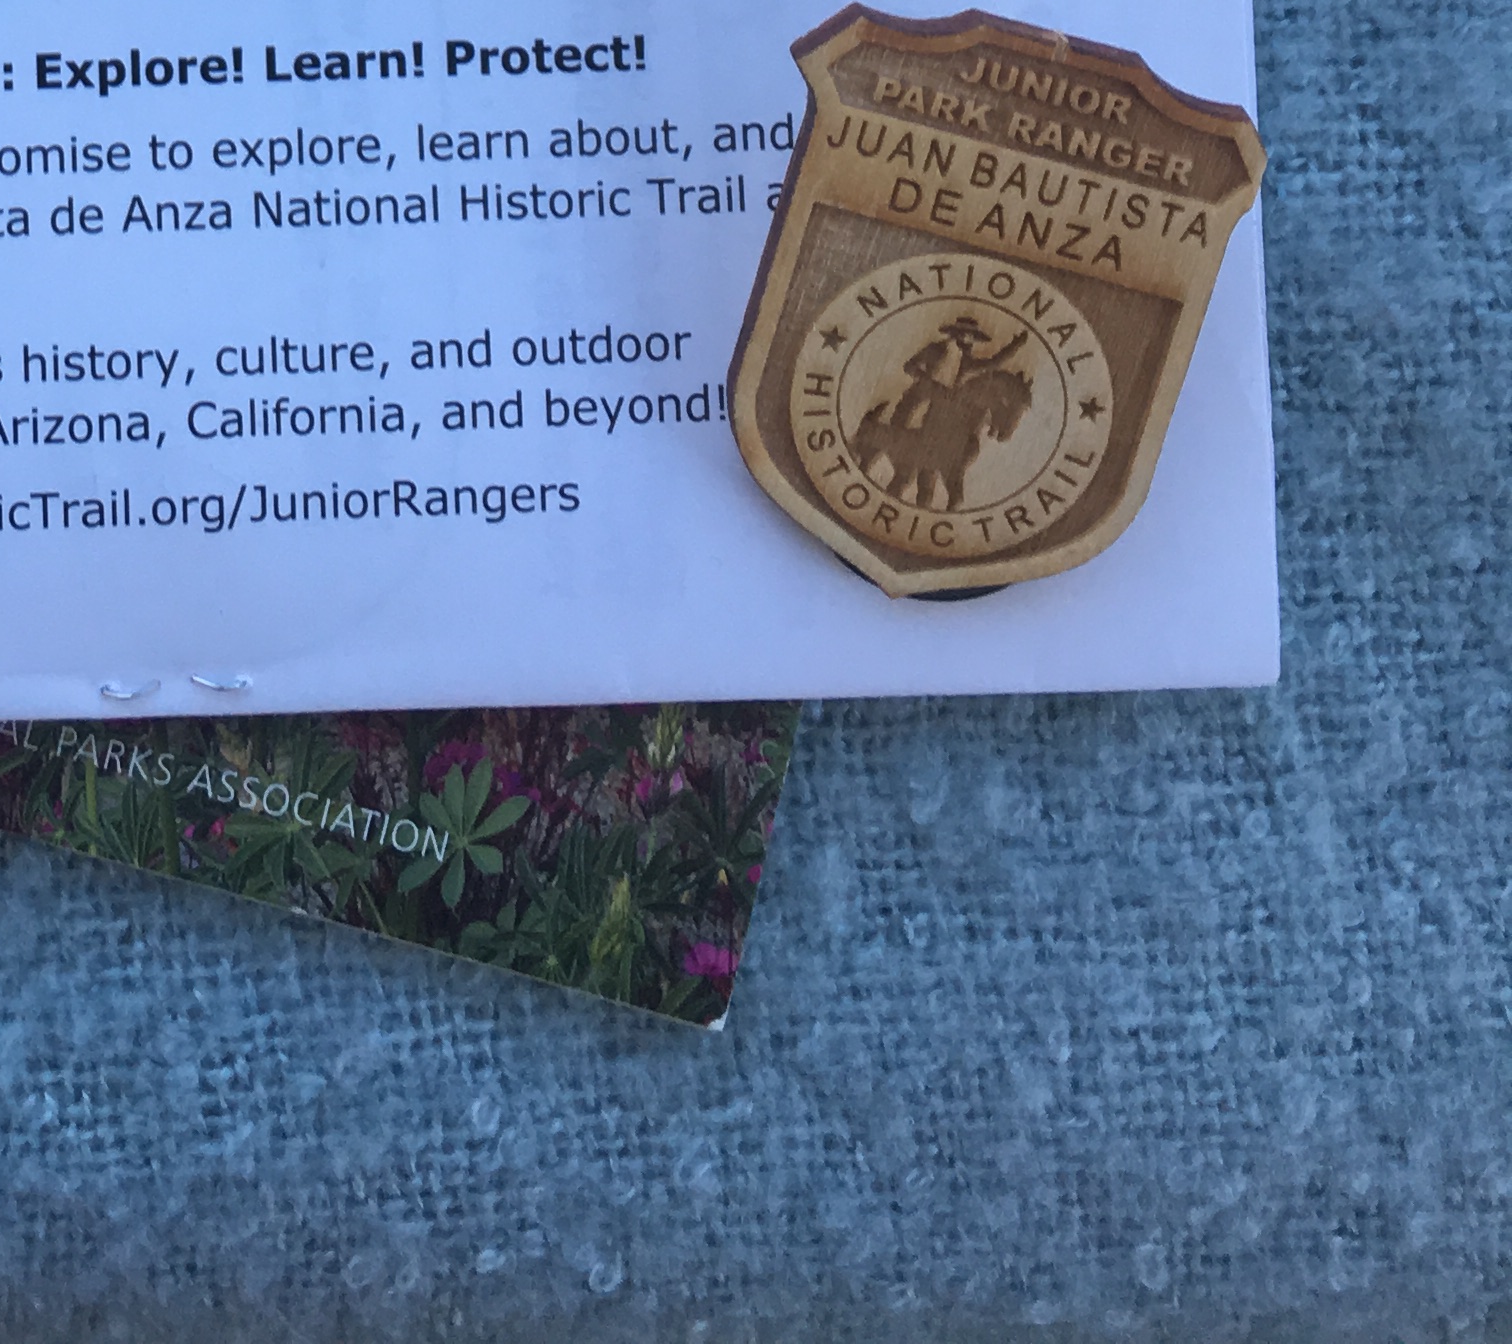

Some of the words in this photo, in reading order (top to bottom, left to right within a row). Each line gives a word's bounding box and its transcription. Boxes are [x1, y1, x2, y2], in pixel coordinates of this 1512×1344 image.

[34, 45, 245, 99] Explore!
[264, 39, 426, 84] Learn!
[444, 32, 648, 79] Protect!
[960, 58, 1132, 125] JUNIOR
[147, 133, 195, 173] to
[211, 125, 398, 178] explore,
[416, 122, 530, 163] learn
[548, 116, 694, 163] about,
[711, 111, 795, 154] and
[873, 77, 993, 132] PARK
[1007, 113, 1194, 186] RANGER
[49, 195, 105, 238] de
[120, 193, 234, 235] Anza
[252, 183, 441, 230] National
[459, 179, 633, 224] Historic
[644, 173, 747, 217] Trail
[826, 116, 956, 178] JUAN
[969, 152, 1209, 249] BAUTISTA
[889, 176, 963, 227] DE
[974, 203, 1123, 272] ANZA
[21, 342, 196, 390] history,
[214, 333, 391, 381] culture,
[409, 327, 493, 372] and
[511, 323, 693, 368] outdoor
[856, 263, 1094, 374] NATIONAL
[186, 394, 422, 442] California,
[440, 388, 525, 433] and
[544, 382, 727, 437] beyond!
[803, 372, 954, 548] HISTORIC
[972, 451, 1096, 543] TRAIL
[56, 724, 174, 787] PARKS
[187, 763, 450, 863] ASSOCIATION
